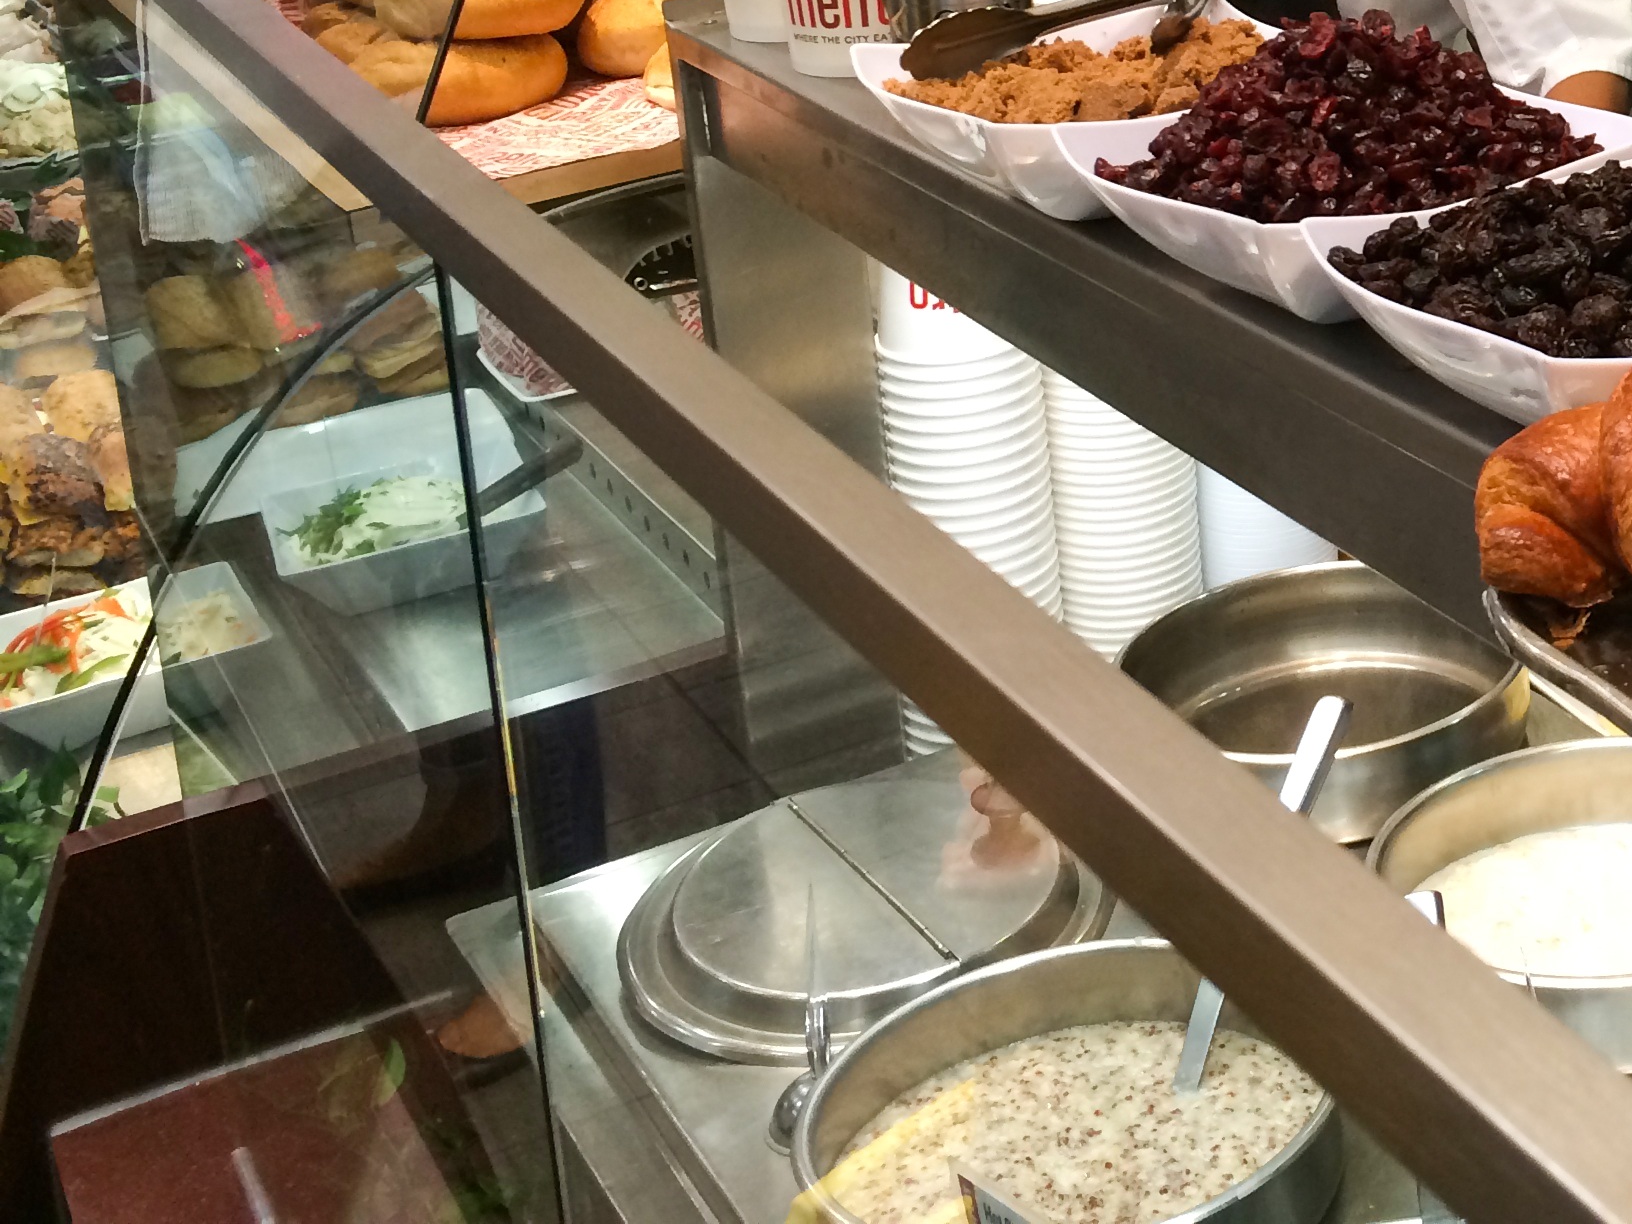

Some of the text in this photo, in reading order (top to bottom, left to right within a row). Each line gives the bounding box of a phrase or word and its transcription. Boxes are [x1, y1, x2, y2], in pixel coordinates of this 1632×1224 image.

[793, 33, 819, 44] WHERE
[821, 35, 841, 44] THE
[844, 35, 870, 44] CITY
